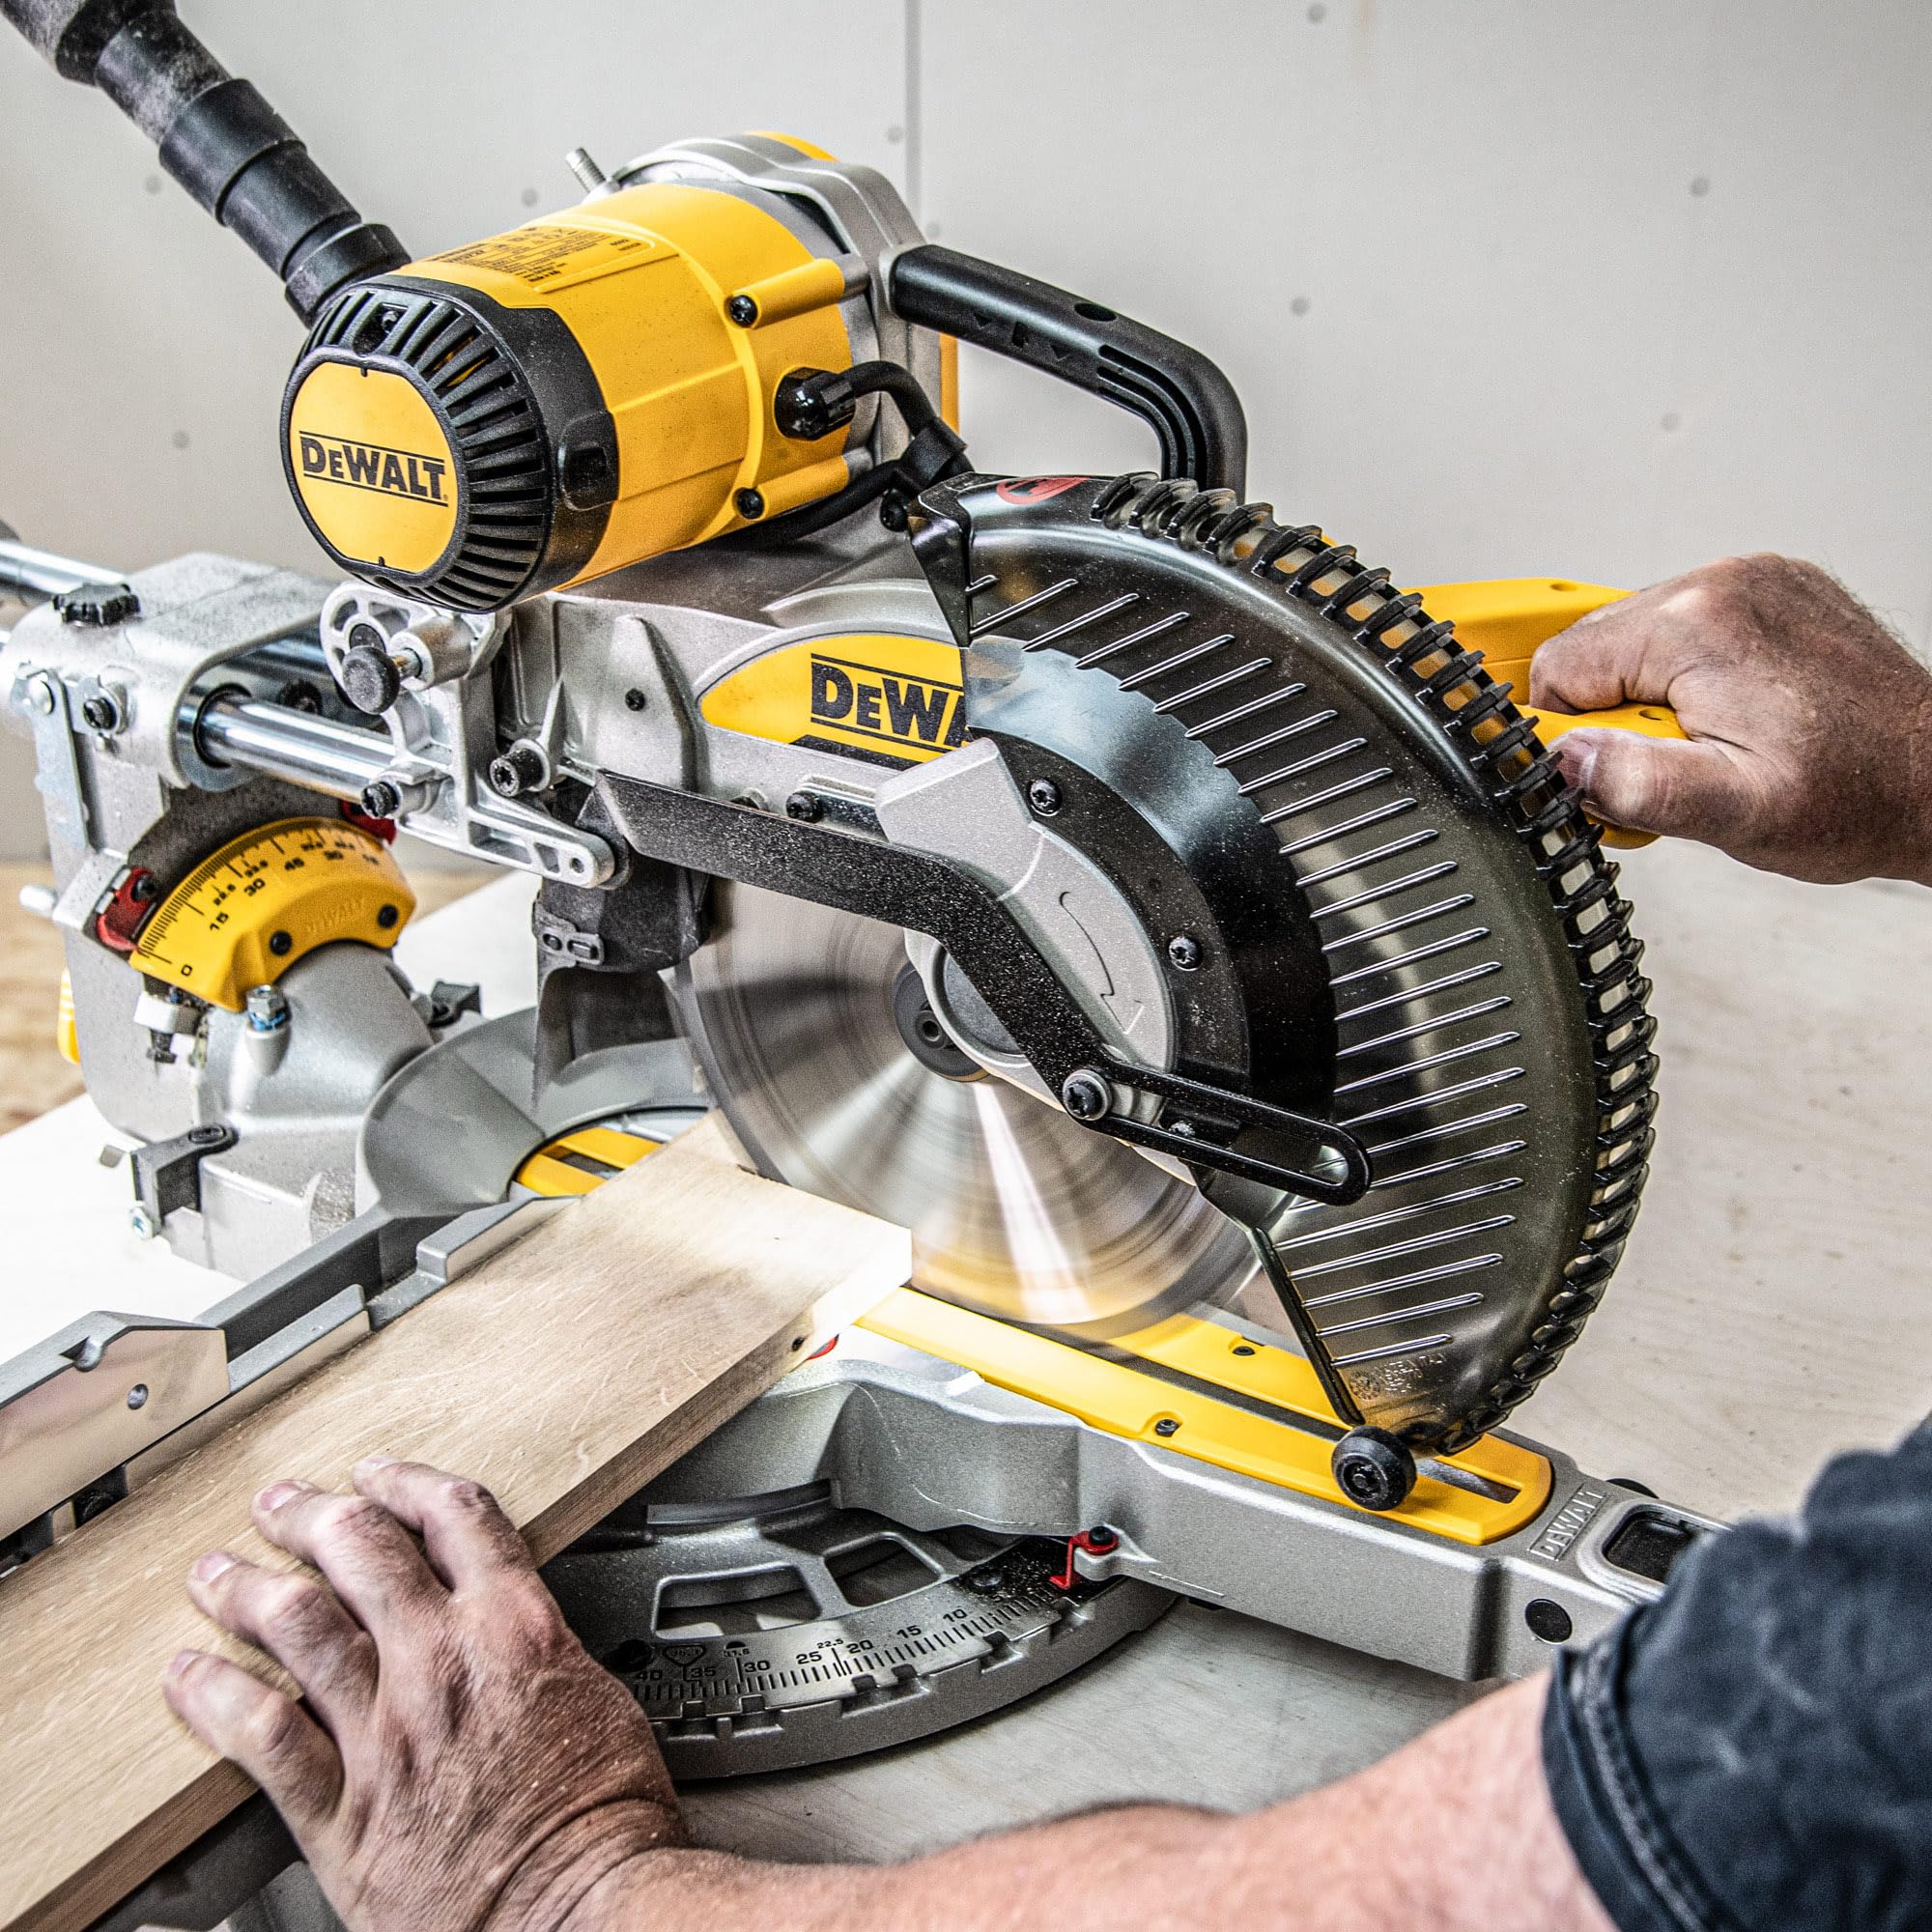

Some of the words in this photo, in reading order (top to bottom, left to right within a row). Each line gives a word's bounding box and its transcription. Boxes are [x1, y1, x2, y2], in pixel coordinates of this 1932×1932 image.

[299, 436, 447, 500] DEWALT
[180, 964, 193, 978] 0
[243, 877, 266, 897] 30
[635, 1668, 664, 1682] 40
[690, 1665, 717, 1679] 35
[743, 1659, 771, 1674] 30
[795, 1650, 823, 1665] 25
[846, 1639, 875, 1655] 20
[895, 1624, 923, 1639] 15
[942, 1607, 968, 1623] 10
[816, 1637, 844, 1650] 22.5
